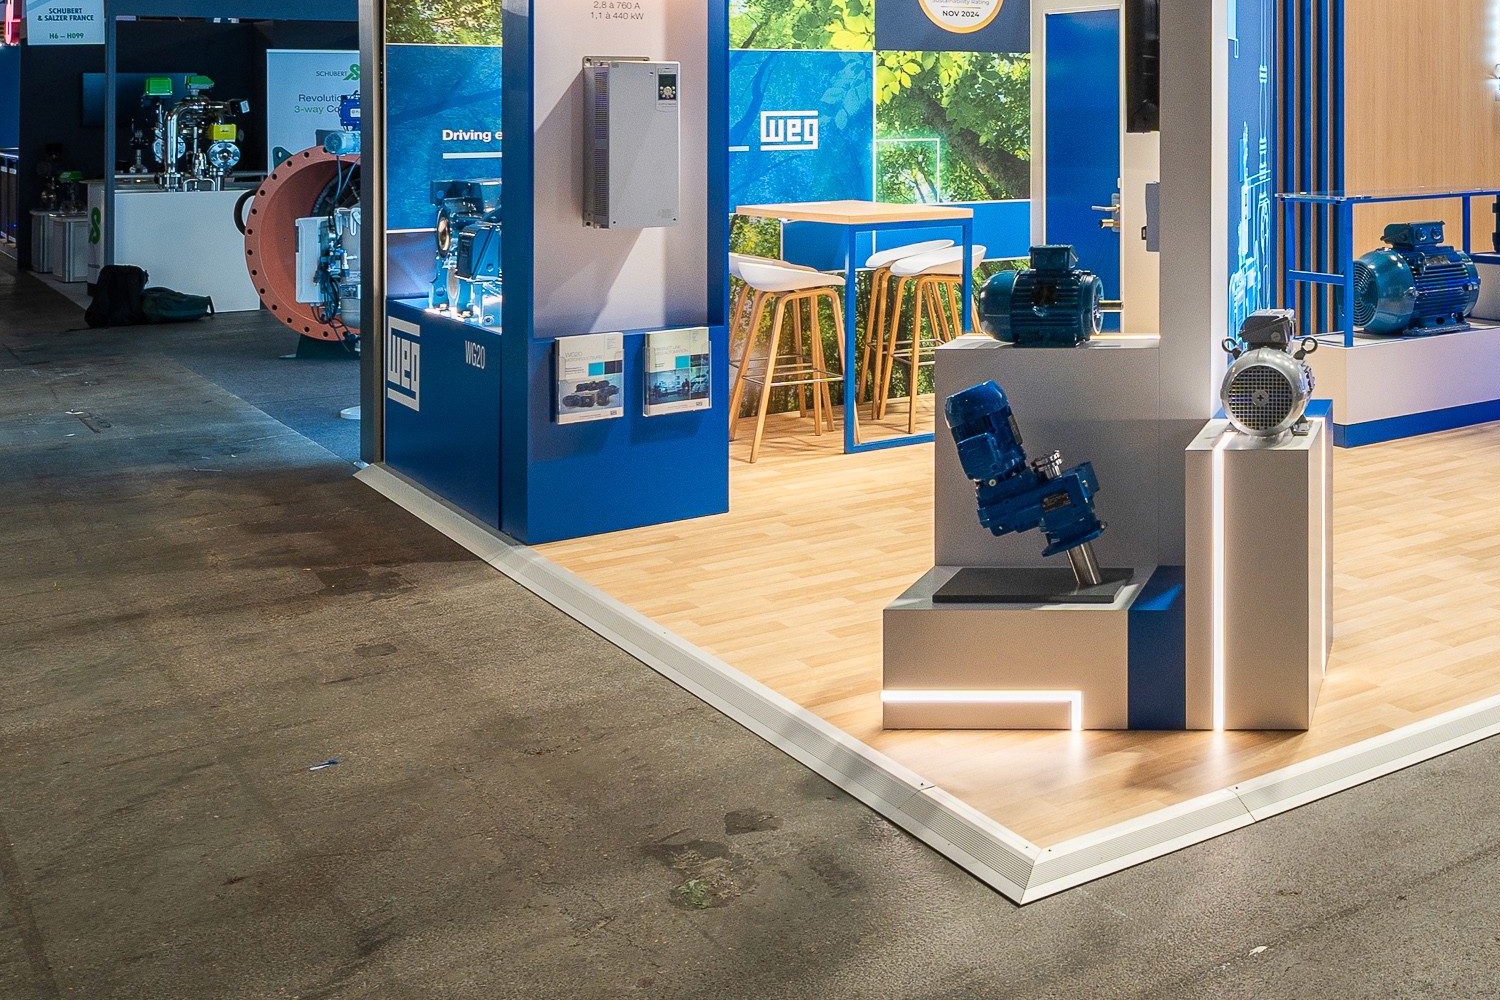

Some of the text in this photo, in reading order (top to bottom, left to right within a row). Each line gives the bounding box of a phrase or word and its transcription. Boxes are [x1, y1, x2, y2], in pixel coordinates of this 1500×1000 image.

[593, 1, 641, 10] 2,8 à 760 A
[590, 11, 645, 20] 1,1 à 440 kW
[49, 32, 59, 40] H6
[294, 105, 324, 114] 3-way
[442, 129, 492, 143] Driving
[464, 340, 486, 370] WG20
